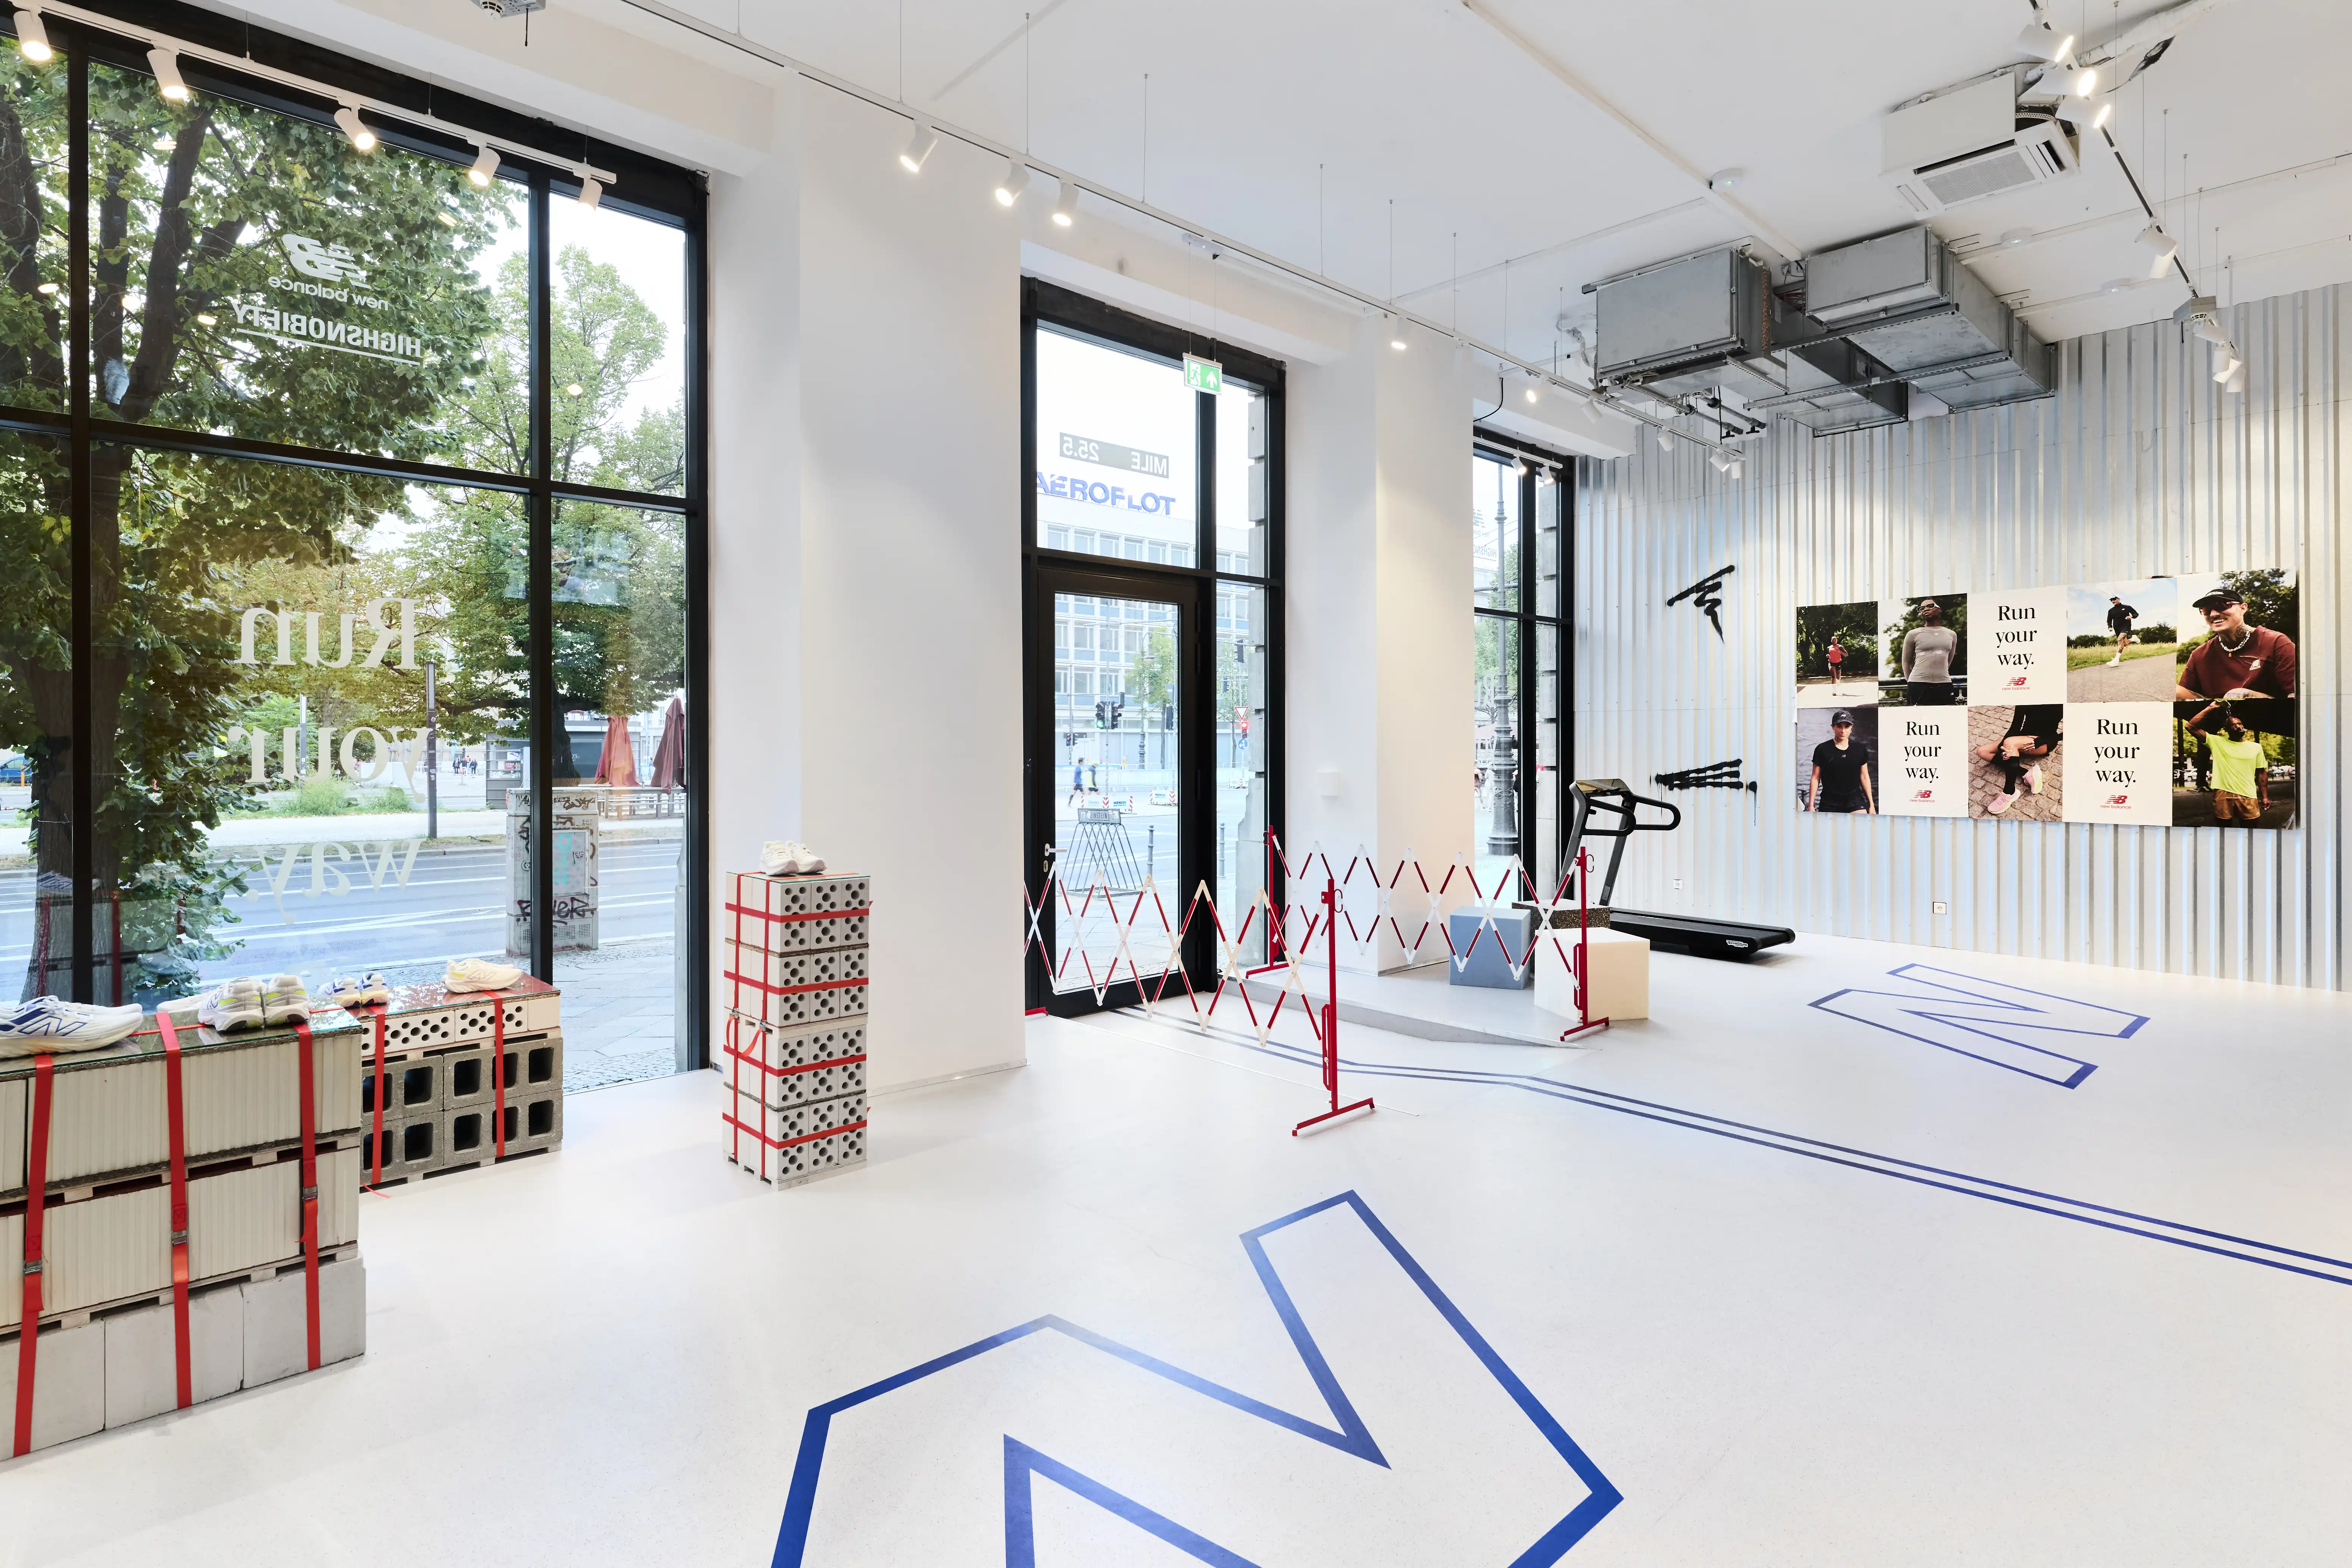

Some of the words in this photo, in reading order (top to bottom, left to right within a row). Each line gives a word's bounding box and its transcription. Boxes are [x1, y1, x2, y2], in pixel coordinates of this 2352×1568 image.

[1037, 471, 1176, 515] AEROFLOT
[1998, 606, 2036, 621] Run
[1995, 628, 2037, 648] your
[1997, 652, 2034, 670] way.
[1906, 721, 1940, 735] Run
[2096, 719, 2138, 735] Run
[1904, 745, 1942, 764] your
[2094, 746, 2140, 763] your
[1905, 767, 1939, 783] way.
[2095, 770, 2136, 788] way.
